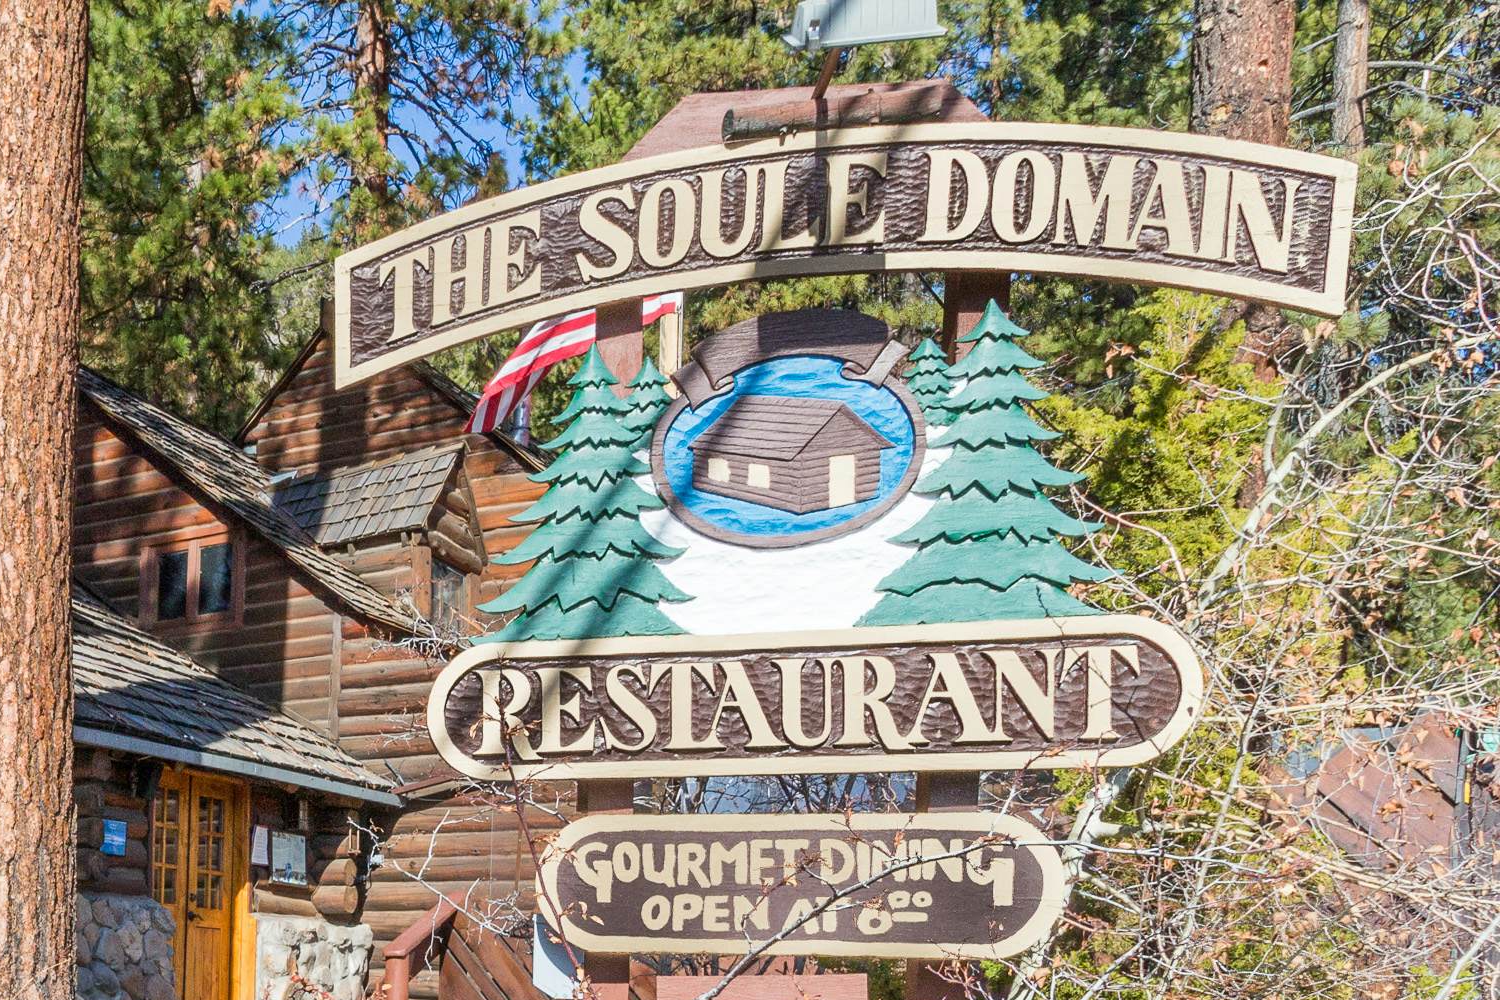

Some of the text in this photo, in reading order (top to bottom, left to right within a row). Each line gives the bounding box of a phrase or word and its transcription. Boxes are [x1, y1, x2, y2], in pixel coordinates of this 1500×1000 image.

[379, 149, 1301, 343] THE SOULE DOMAIN
[472, 645, 1141, 761] RESTAURANT
[573, 837, 1015, 906] GOURMET DINING
[641, 893, 770, 932] OPEN
[782, 896, 851, 935] AT
